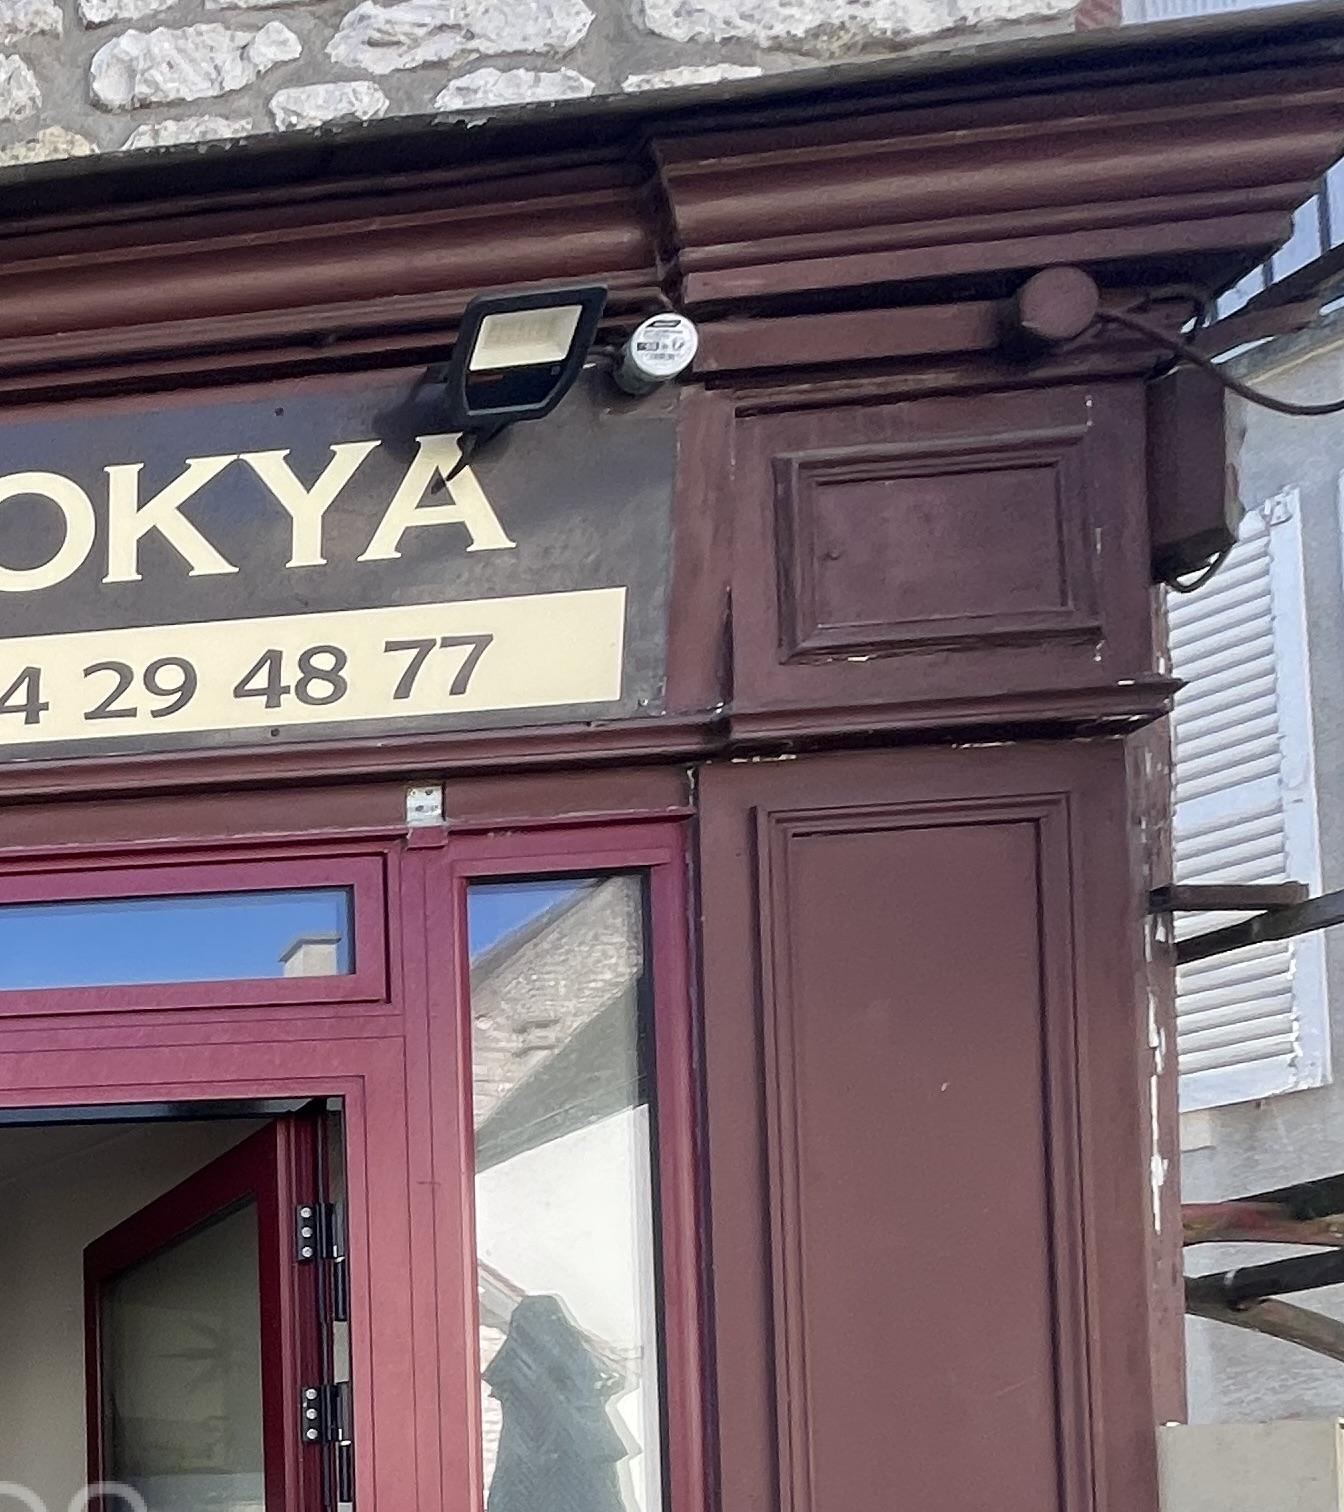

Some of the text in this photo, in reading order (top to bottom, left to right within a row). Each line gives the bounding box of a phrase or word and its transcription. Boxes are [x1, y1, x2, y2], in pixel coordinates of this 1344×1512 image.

[82, 656, 199, 722] 29
[232, 643, 349, 708] 48
[383, 633, 495, 700] 77
